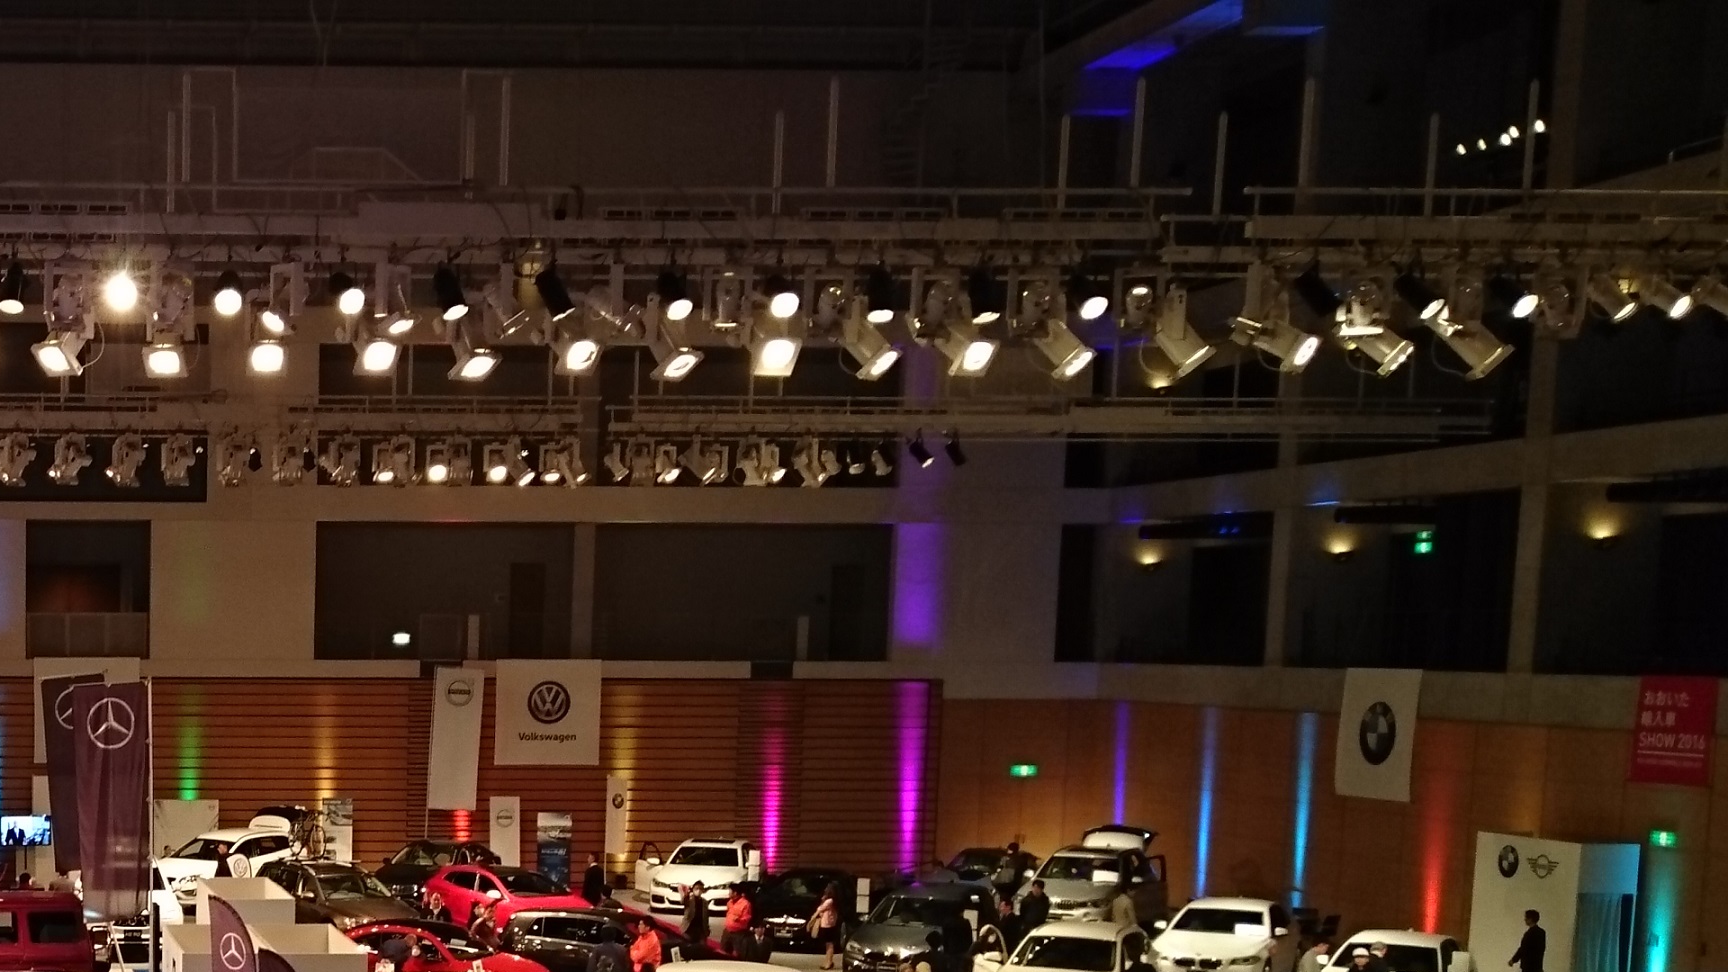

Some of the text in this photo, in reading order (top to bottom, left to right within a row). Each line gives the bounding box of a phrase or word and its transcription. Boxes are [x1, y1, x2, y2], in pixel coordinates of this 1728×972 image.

[518, 731, 577, 744] Volkswagen
[1638, 731, 1706, 750] SHOW 2016
